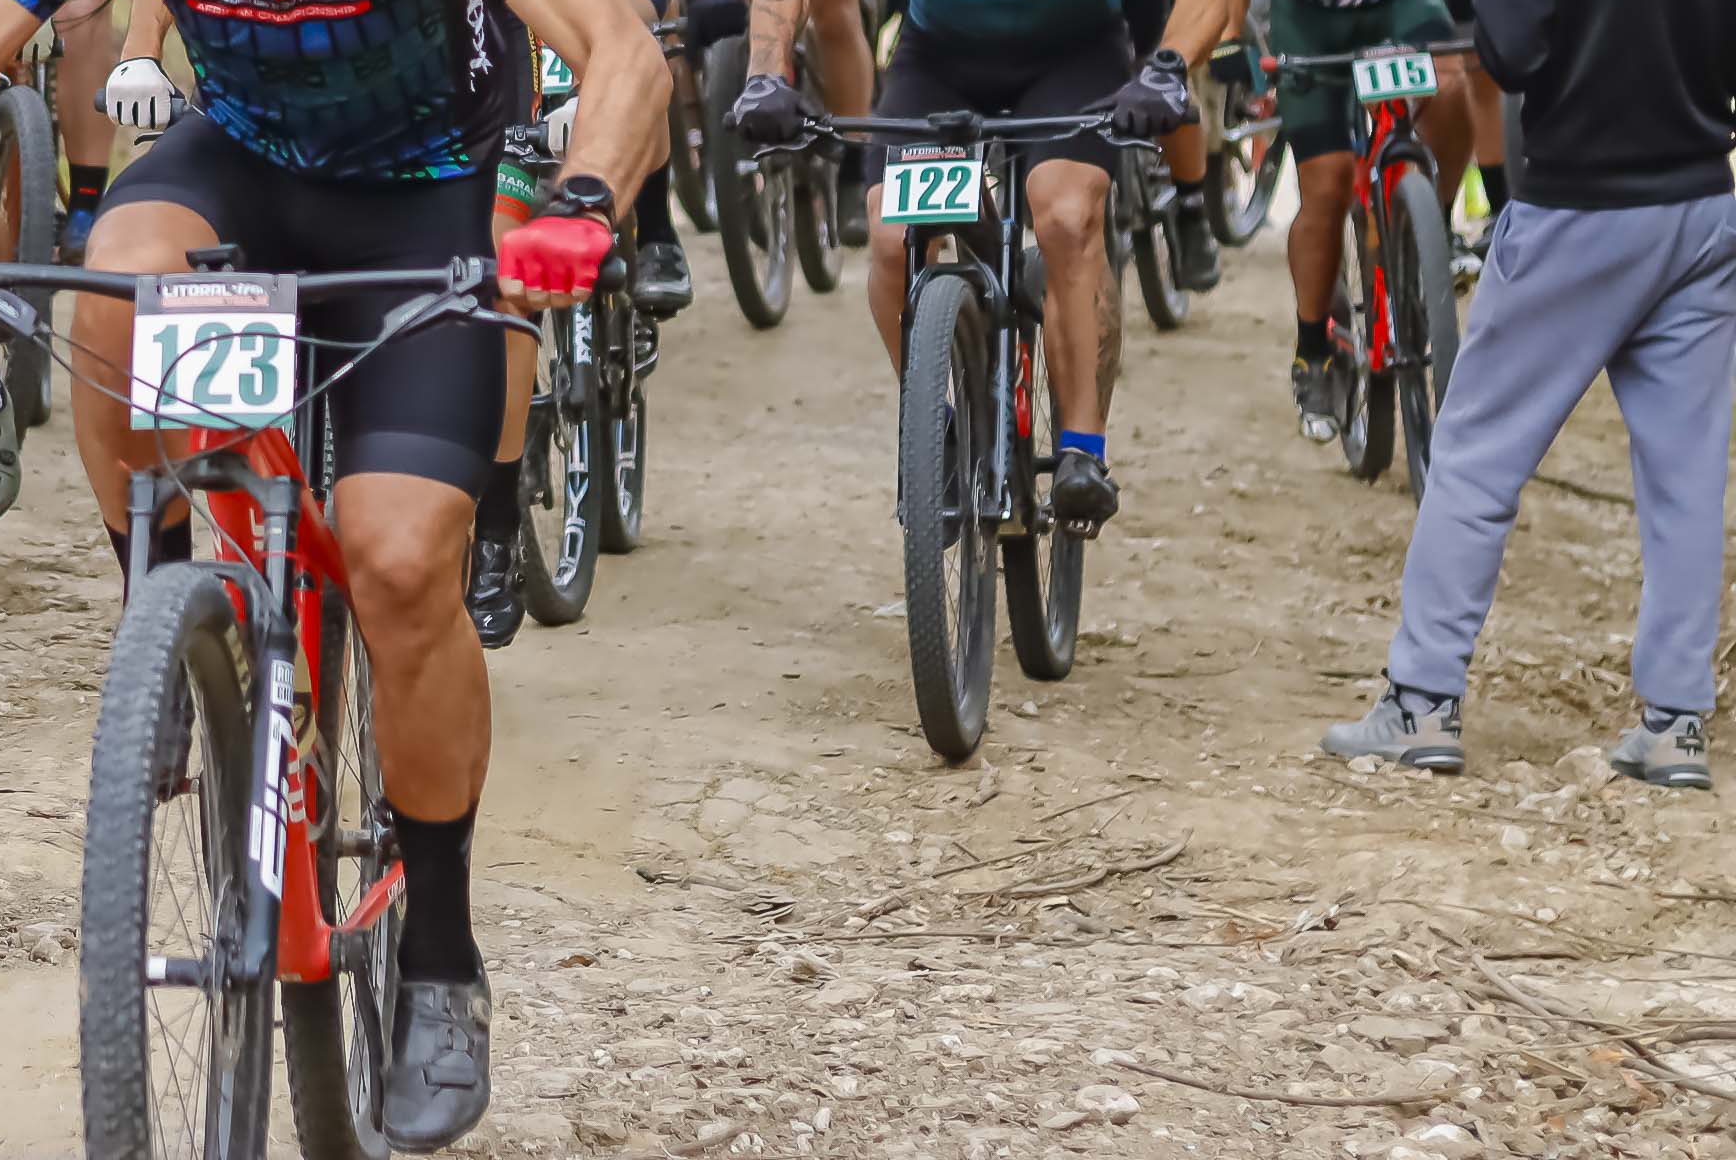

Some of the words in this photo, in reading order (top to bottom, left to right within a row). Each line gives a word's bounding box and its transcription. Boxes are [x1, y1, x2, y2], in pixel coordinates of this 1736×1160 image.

[1366, 60, 1427, 90] 115
[895, 165, 973, 212] 122
[152, 321, 281, 407] 123
